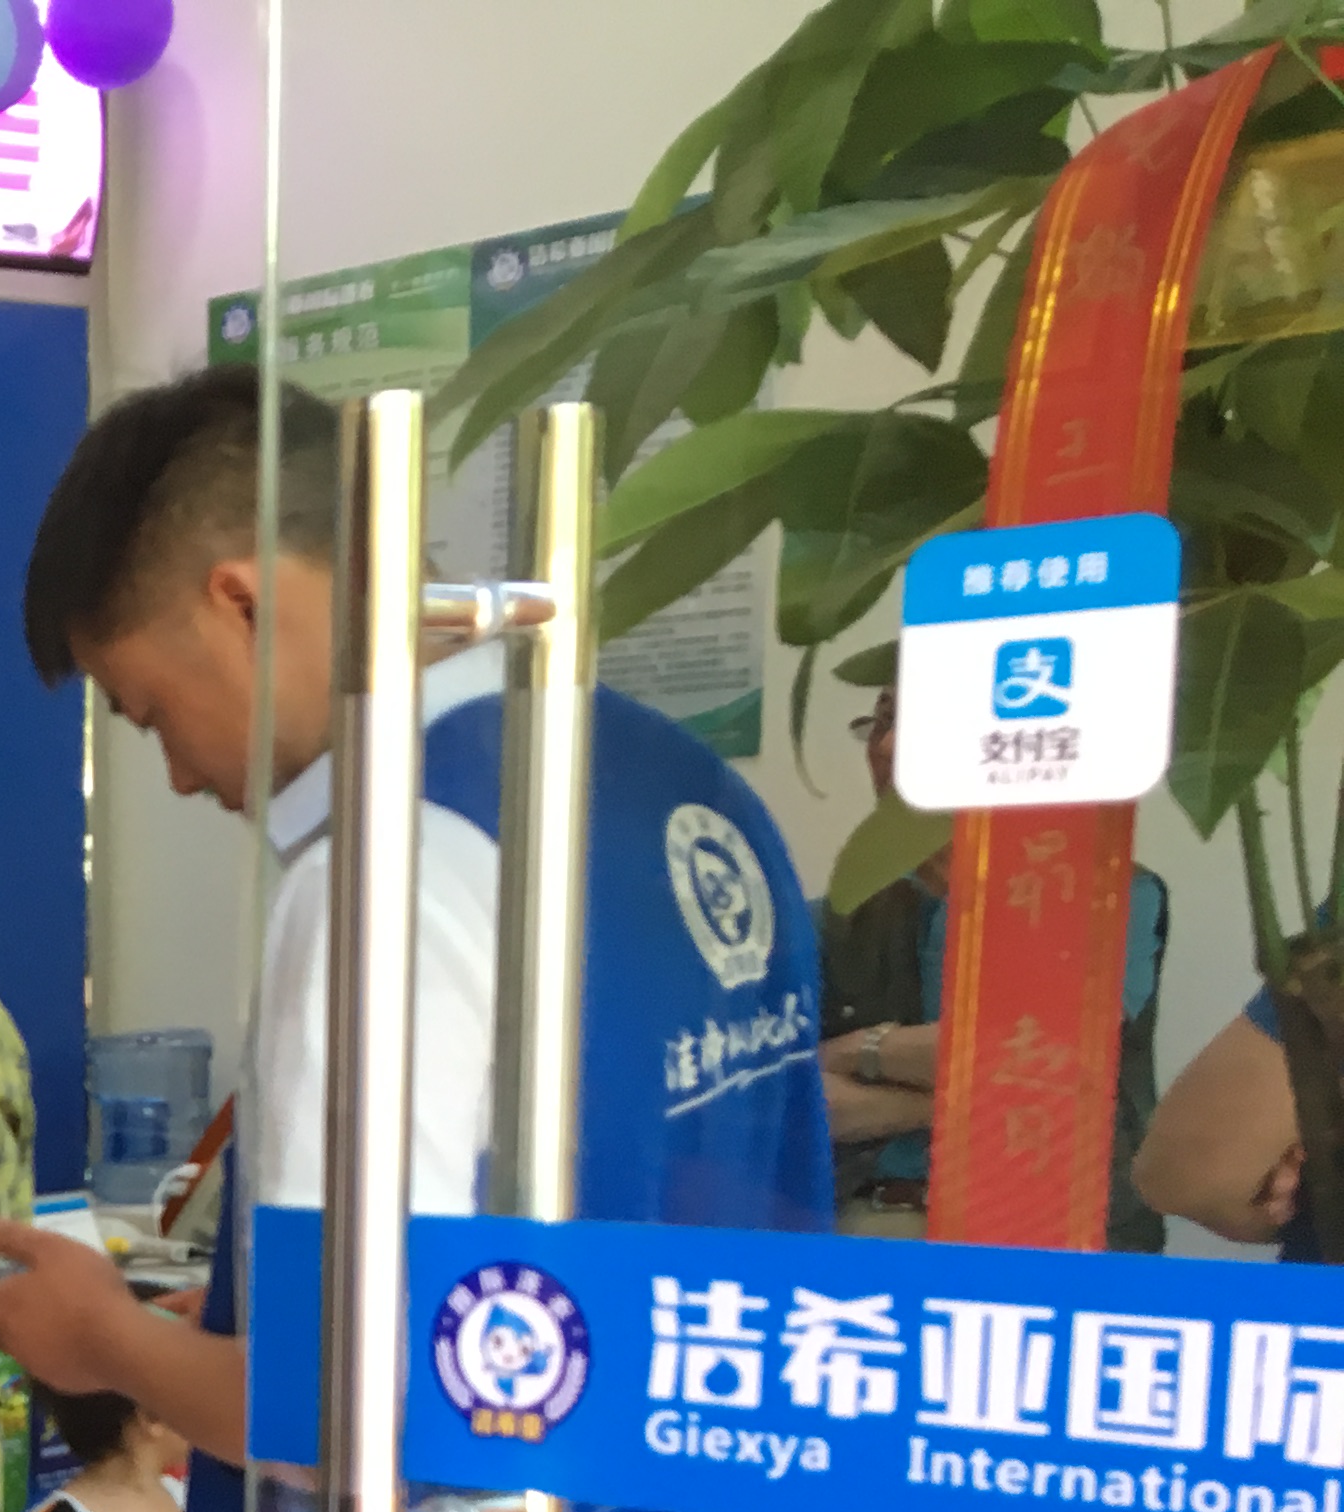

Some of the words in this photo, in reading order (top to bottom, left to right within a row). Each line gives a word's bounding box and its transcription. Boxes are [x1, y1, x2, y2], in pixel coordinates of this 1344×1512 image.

[979, 726, 1081, 765] 支付宝
[647, 1275, 1344, 1470] 洁希亚国际
[645, 1408, 831, 1480] Giexya
